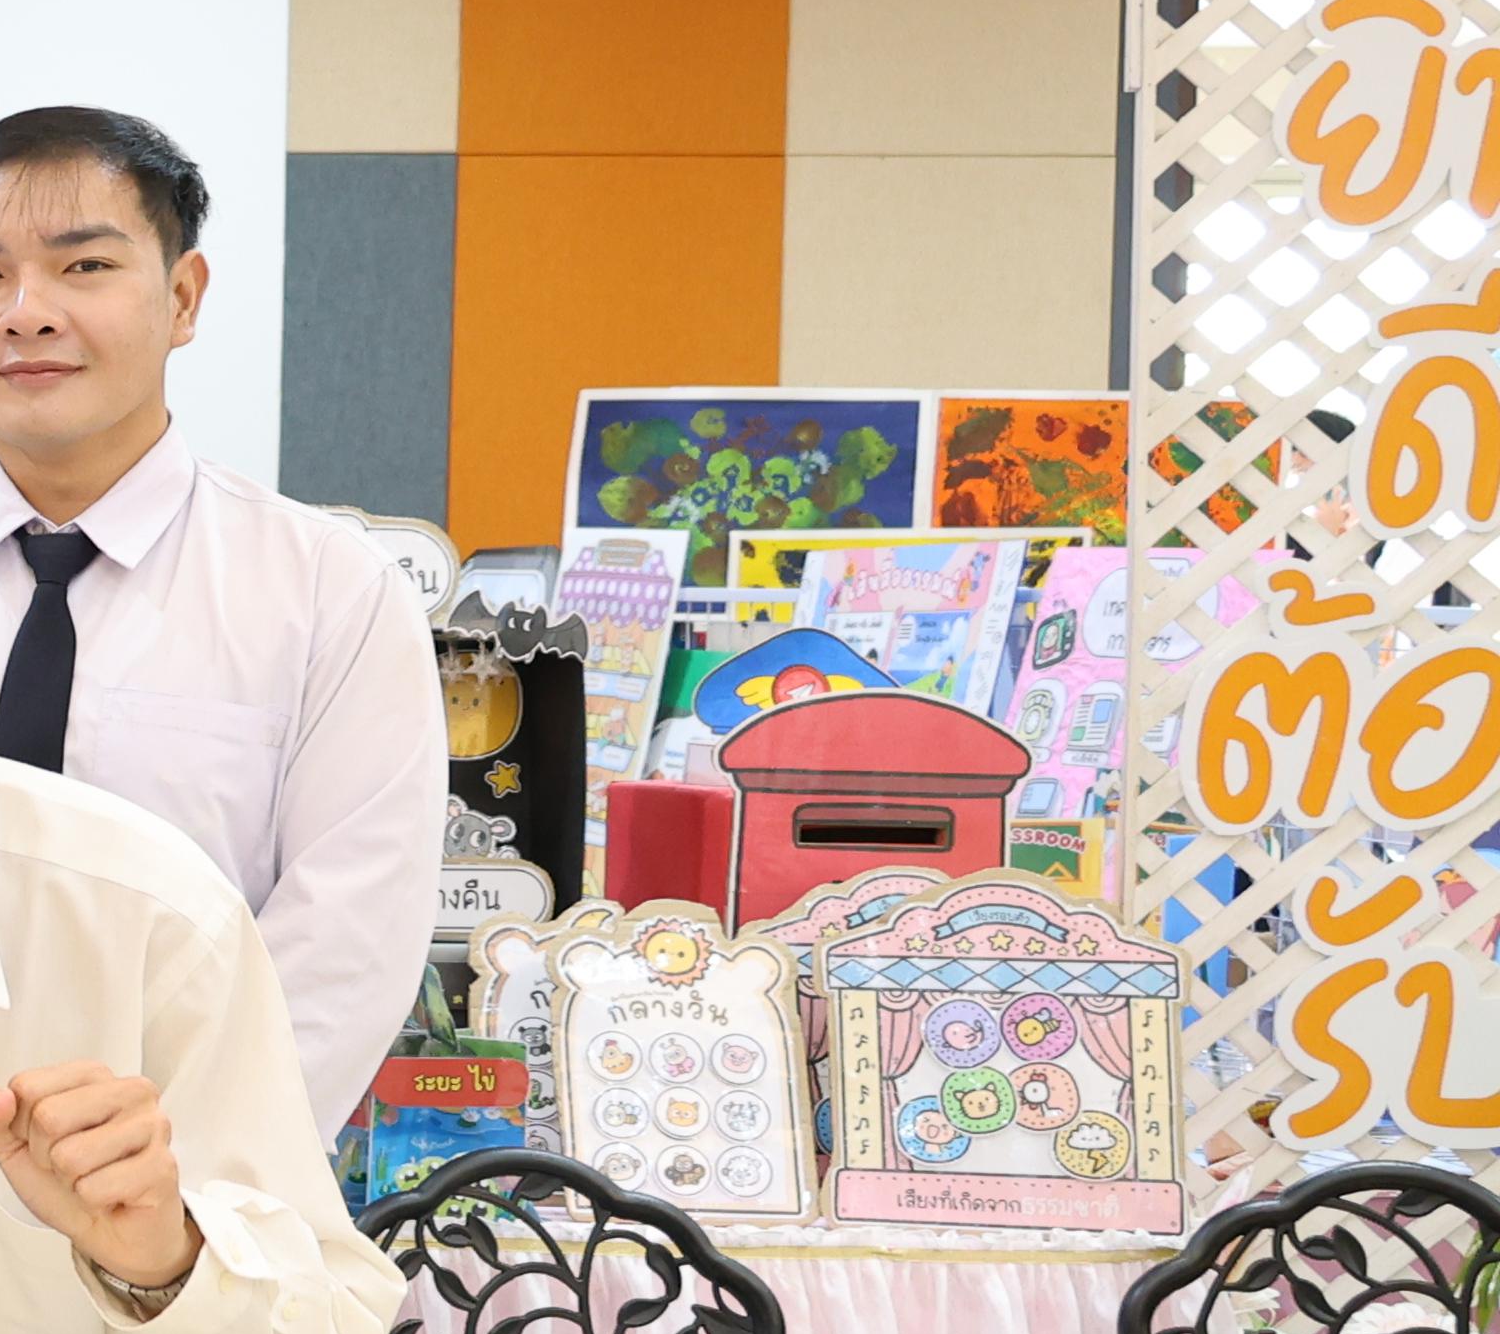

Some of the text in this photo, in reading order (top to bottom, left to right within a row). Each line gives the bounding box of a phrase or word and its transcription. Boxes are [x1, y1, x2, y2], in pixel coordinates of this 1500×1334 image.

[1011, 828, 1086, 853] SSROOM
[439, 878, 501, 911] างคืน
[607, 989, 729, 1027] กลางวัน
[413, 1073, 462, 1093] ระยะ
